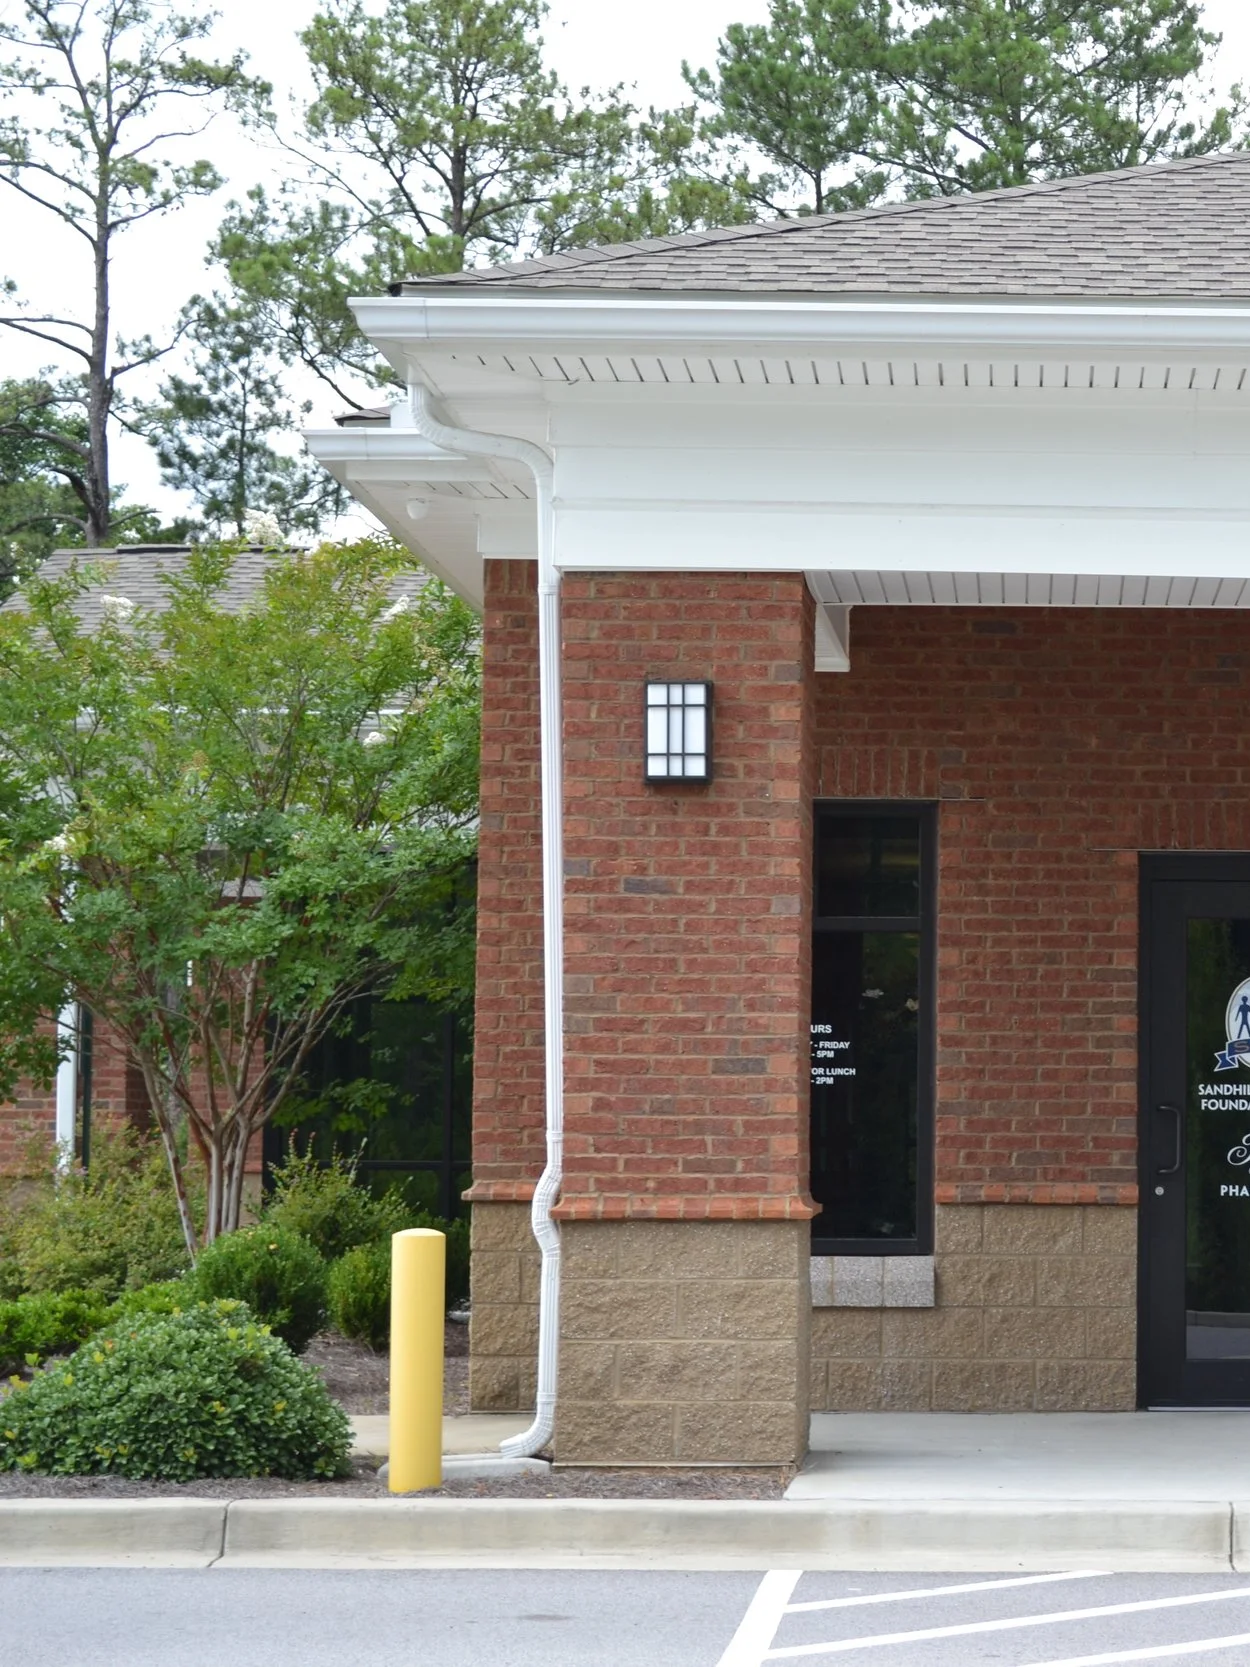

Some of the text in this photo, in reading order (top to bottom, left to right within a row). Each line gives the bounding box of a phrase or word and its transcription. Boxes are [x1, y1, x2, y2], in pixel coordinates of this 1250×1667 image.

[810, 1024, 832, 1033] URS
[819, 1041, 850, 1049] FRIDAY
[816, 1050, 834, 1058] 5PM
[811, 1067, 856, 1075] OR LUNCH
[815, 1076, 834, 1084] 2PM
